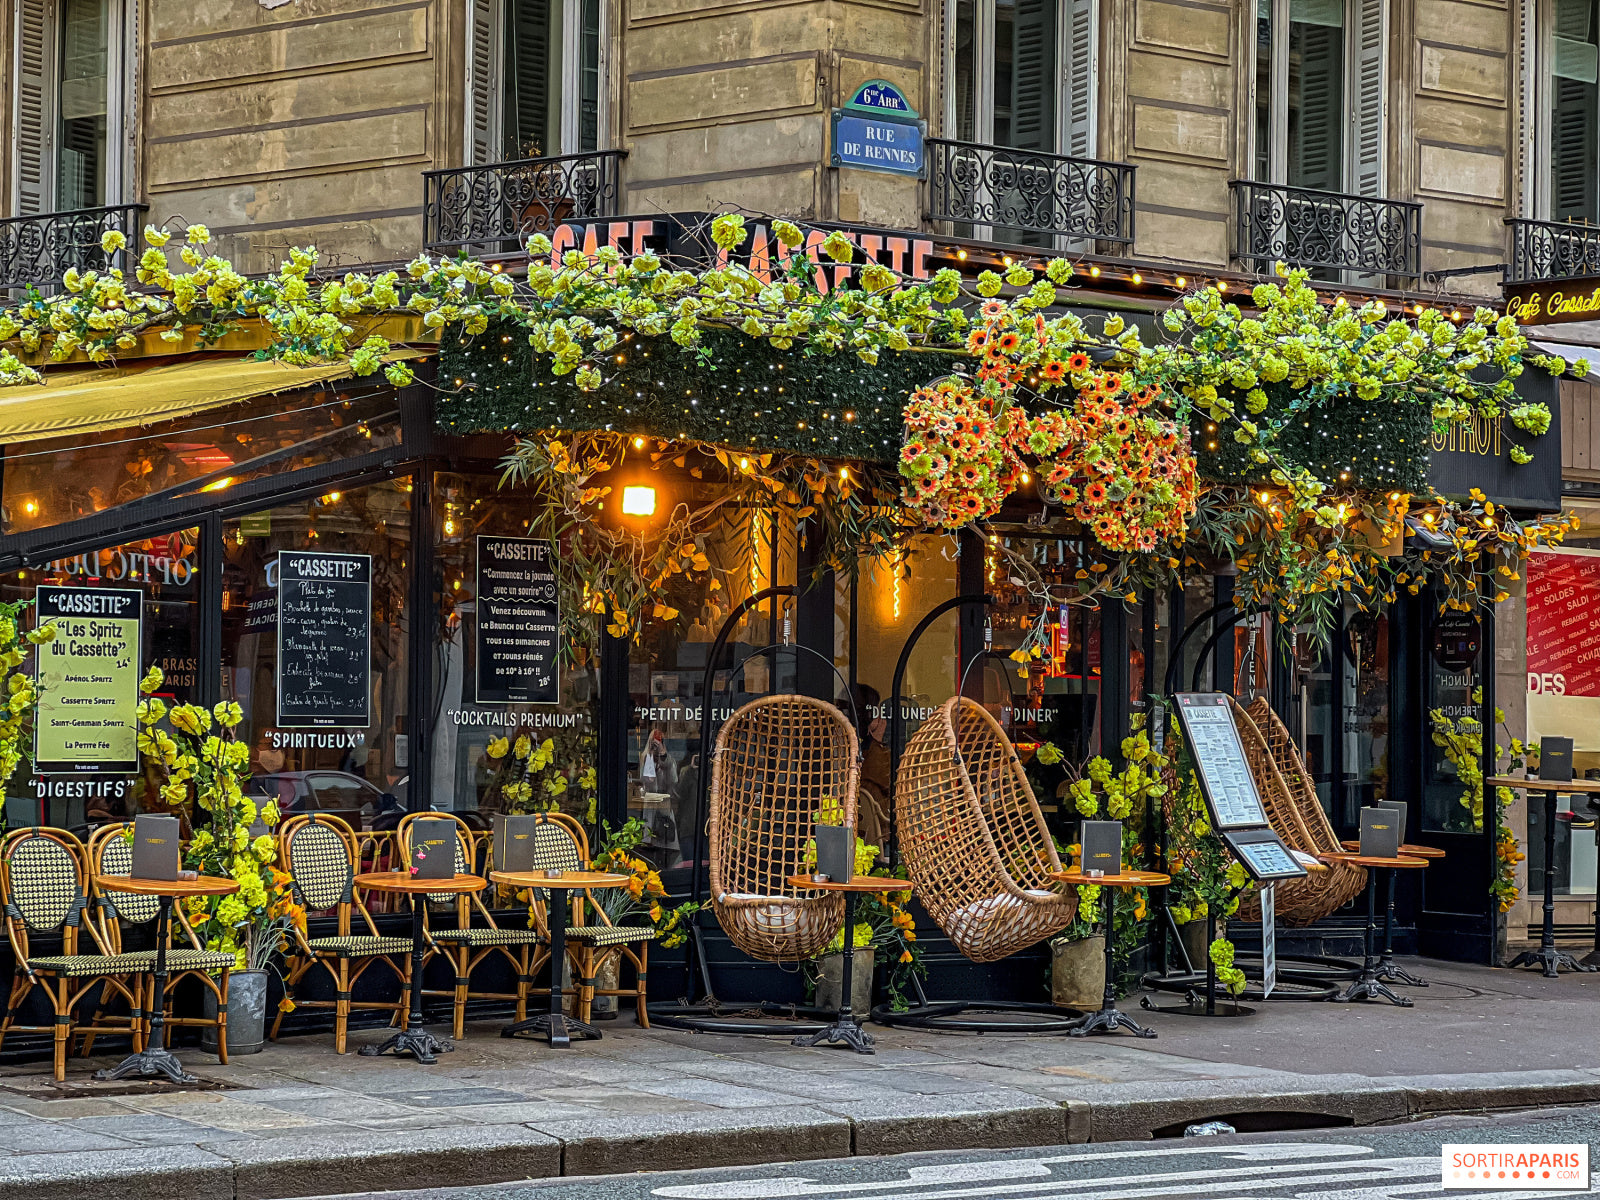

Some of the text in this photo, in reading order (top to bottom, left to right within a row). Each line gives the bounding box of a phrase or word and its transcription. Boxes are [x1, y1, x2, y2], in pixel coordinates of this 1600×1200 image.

[866, 126, 894, 143] RUE
[843, 142, 916, 164] DE RENNES
[1507, 292, 1541, 320] Café
[487, 542, 550, 562] “CASSETTE”
[289, 559, 361, 578] “CASSETTE”
[524, 570, 531, 580] la
[1580, 565, 1597, 577] SALE
[493, 586, 508, 595] avec
[508, 586, 517, 595] un
[1535, 582, 1552, 595] SALE
[1544, 586, 1575, 606] SOLDES
[48, 594, 131, 614] “CASSETTE”
[490, 605, 511, 615] Venez
[1566, 594, 1590, 611] SALDI
[57, 620, 123, 641] “Les Spritz
[490, 620, 514, 630] Brunch
[515, 623, 524, 631] du
[525, 622, 556, 632] Cassette
[52, 639, 126, 658] du Cassette”
[485, 637, 551, 647] tous les dimanches
[65, 674, 113, 683] Apérol Spritz
[496, 667, 504, 675] de
[518, 666, 522, 675] à
[61, 697, 116, 705] Cassette Spritz
[447, 708, 583, 728] “COCKTAILS PREMIUM”
[634, 705, 681, 721] “PETIT
[1005, 706, 1059, 722] “DINER”
[51, 719, 125, 727] Saint-Germain Spritz
[65, 740, 110, 749] La Petite Fée
[264, 731, 365, 749] “SPIRITUEUX”
[28, 779, 135, 798] “DIGESTIFS”
